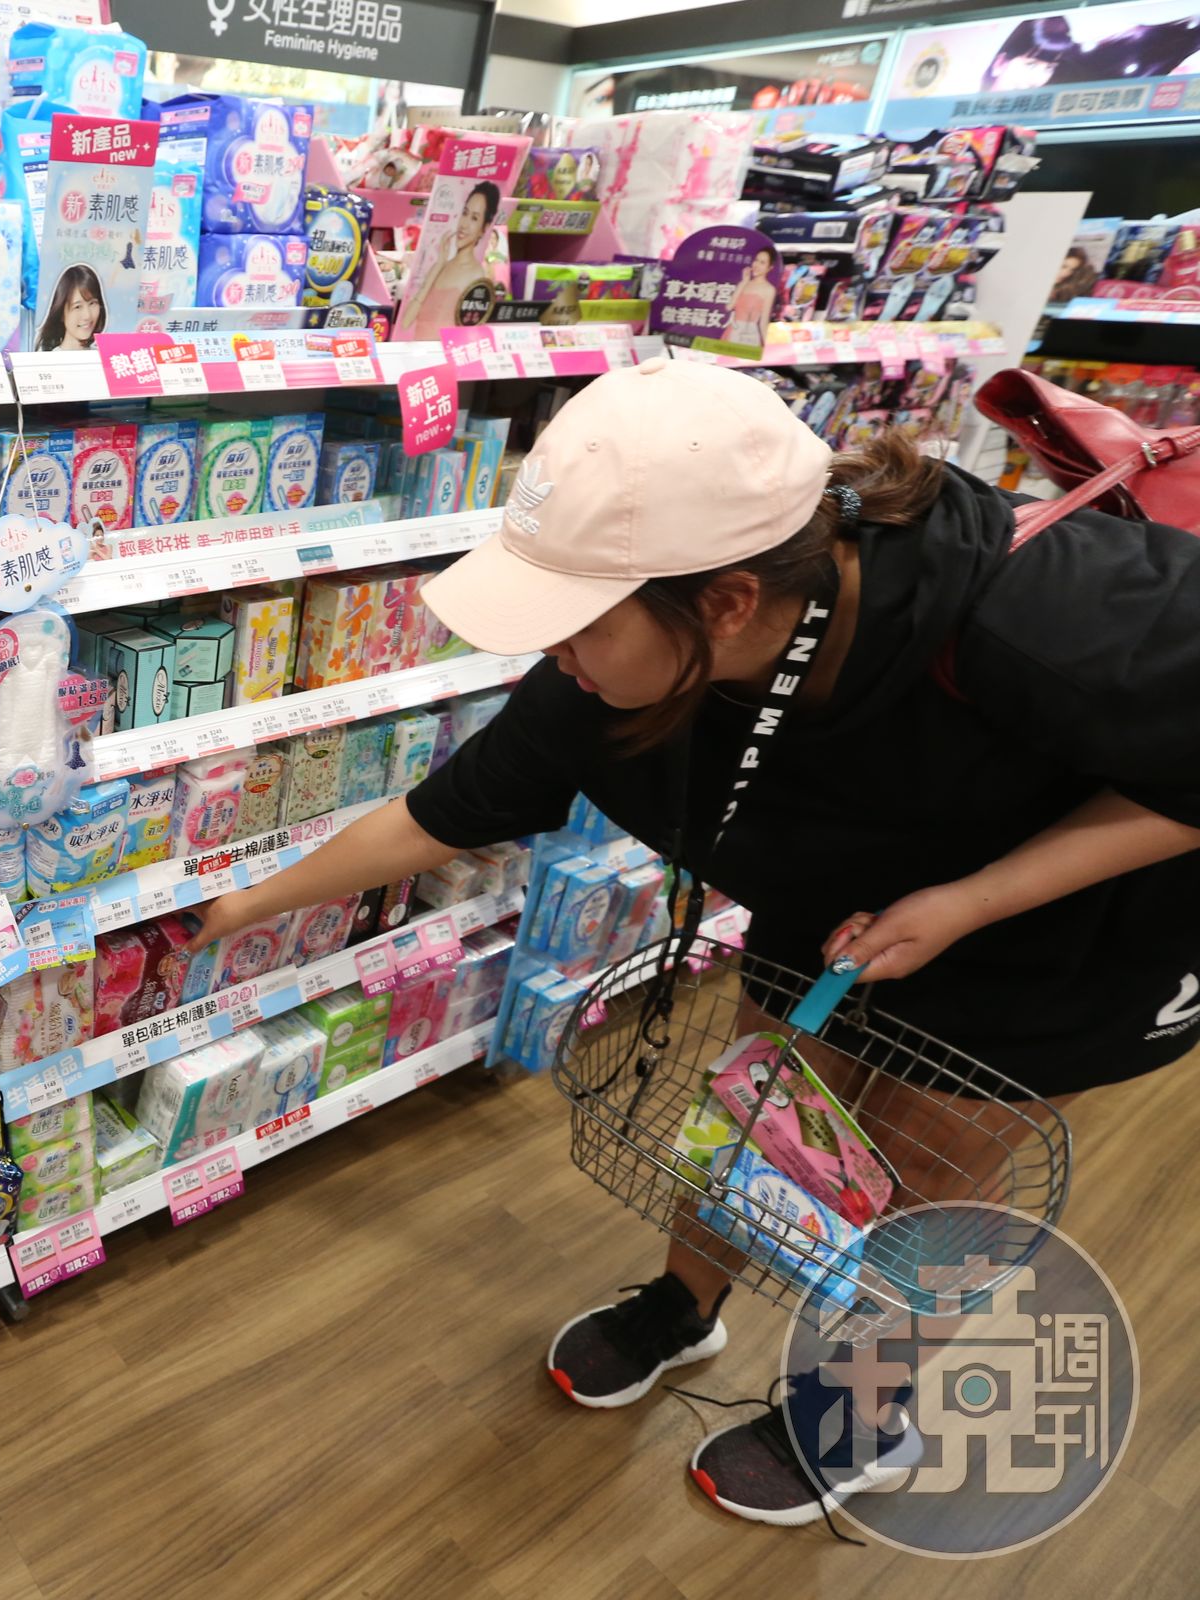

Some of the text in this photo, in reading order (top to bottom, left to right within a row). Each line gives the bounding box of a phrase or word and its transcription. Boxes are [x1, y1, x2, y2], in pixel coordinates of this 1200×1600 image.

[242, 0, 403, 44] 女性生理用品
[264, 30, 378, 61] Feminine Hygiene
[71, 124, 132, 155] 新產品
[110, 147, 137, 163] new
[453, 145, 497, 170] 新產品
[89, 194, 138, 222] 素肌感
[110, 344, 156, 380] 熱銷
[406, 376, 439, 407] 新品
[423, 394, 452, 425] 上市
[415, 425, 439, 446] new
[1, 546, 54, 586] 素肌感
[712, 600, 829, 850] UIPMENT
[122, 1000, 217, 1047] 單包衛生棉/護墊
